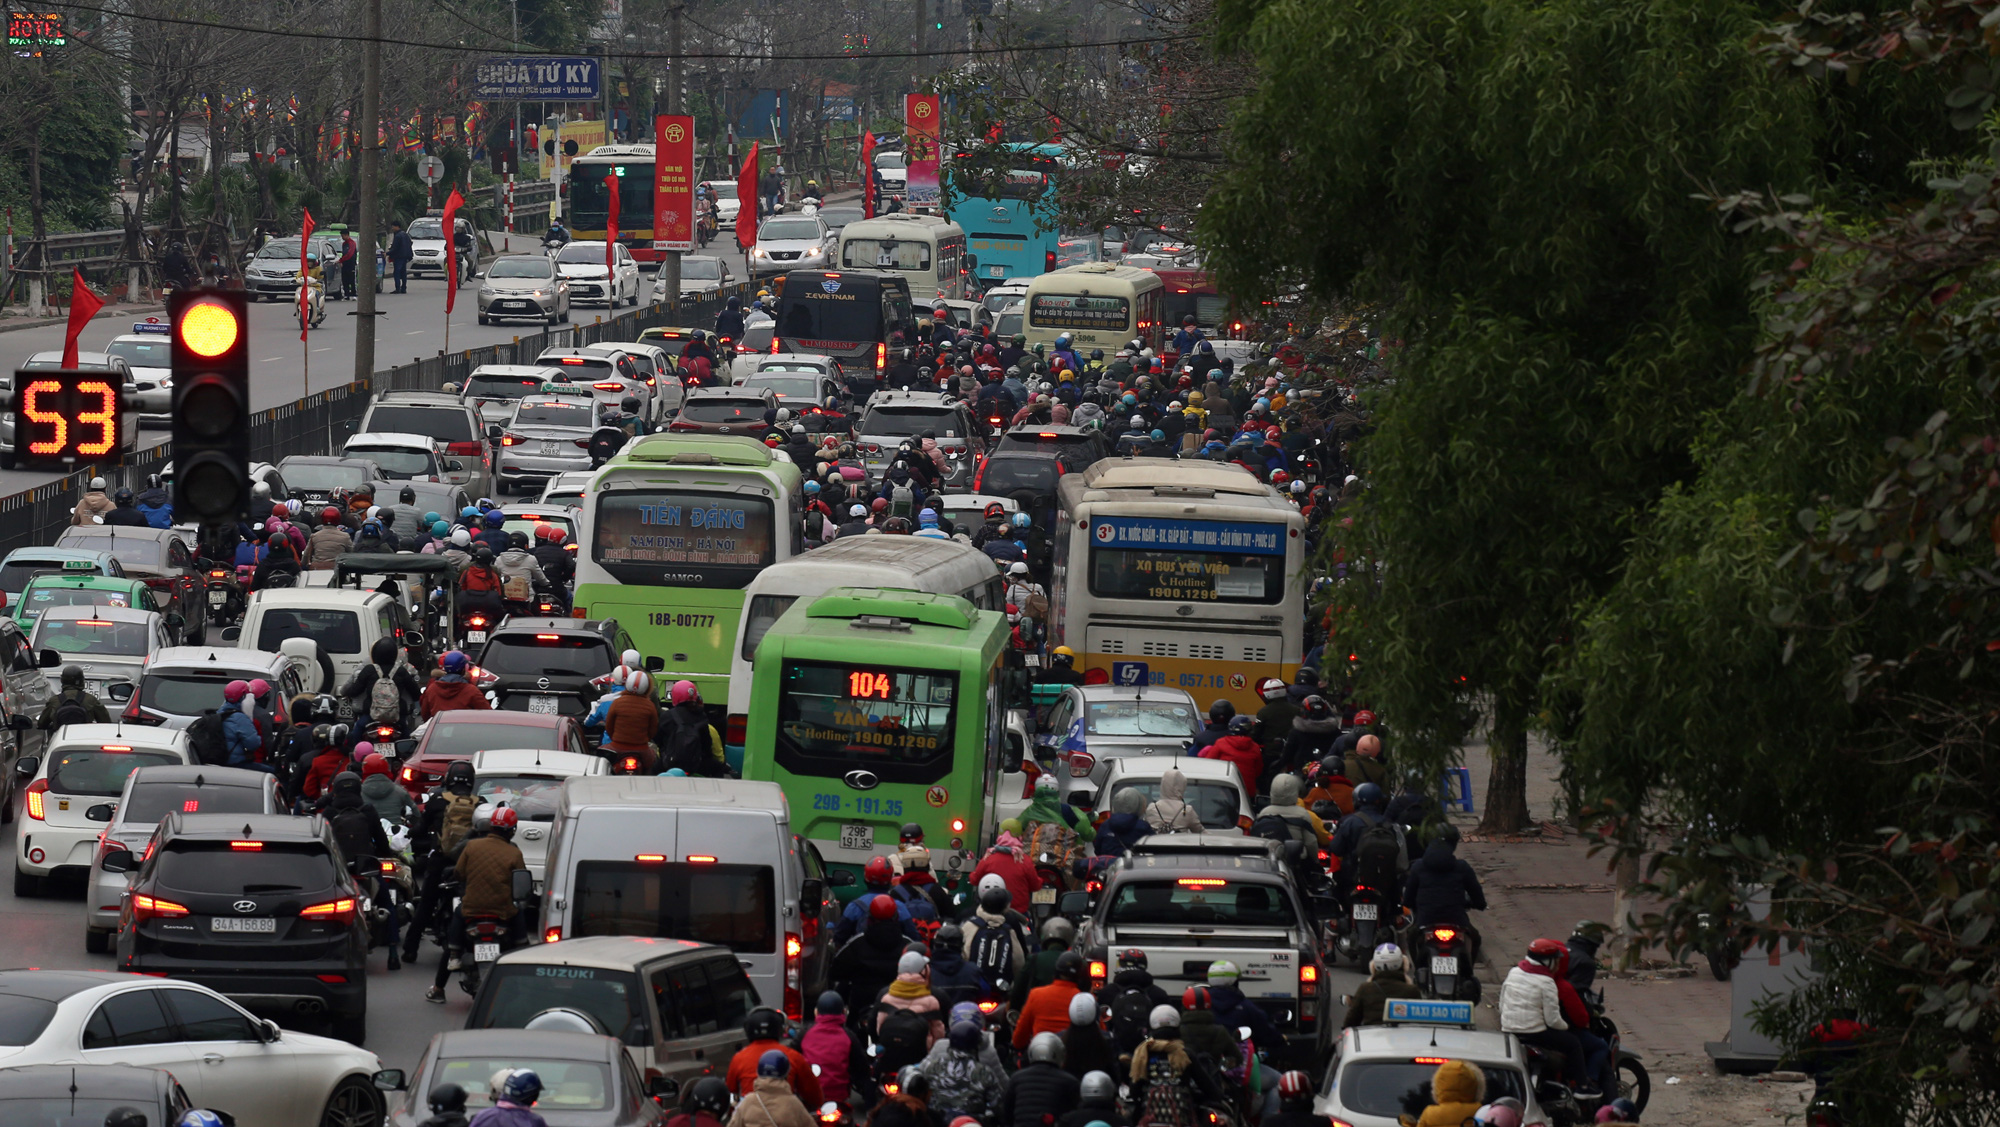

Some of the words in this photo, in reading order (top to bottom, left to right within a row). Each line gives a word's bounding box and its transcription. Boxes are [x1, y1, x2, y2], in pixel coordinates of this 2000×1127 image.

[9, 20, 63, 37] HOTEL
[565, 60, 592, 83] KỲ
[879, 255, 892, 264] 11
[24, 380, 115, 455] 53
[639, 498, 682, 526] TIẾN
[690, 503, 745, 530] ĐĂNG
[630, 535, 654, 547] NAM
[656, 536, 684, 549] ĐỊNH
[715, 536, 736, 552] NỘI
[604, 547, 632, 560] NGHĨA
[1155, 561, 1175, 572] BUS
[663, 573, 703, 583] SAMCO
[1169, 577, 1206, 587] Hotline
[1148, 588, 1218, 600] 1900.1296
[648, 612, 715, 628] 18B-00777
[1121, 664, 1141, 683] G7
[1148, 671, 1165, 685] 9B
[1179, 673, 1225, 688] 057.16
[849, 671, 890, 699] 104
[536, 696, 552, 704] 30E
[805, 727, 848, 742] Hotline
[854, 730, 937, 750] 1900.1296
[813, 793, 841, 811] 29B
[856, 797, 903, 817] 191.35
[848, 826, 866, 838] 29B
[842, 836, 872, 849] 191.35
[214, 919, 274, 931] 34A-156.89
[535, 967, 595, 979] SUZUKI
[1410, 1005, 1430, 1017] TAXI
[1431, 1007, 1449, 1018] SAO
[1450, 1007, 1469, 1019] VIỆT
